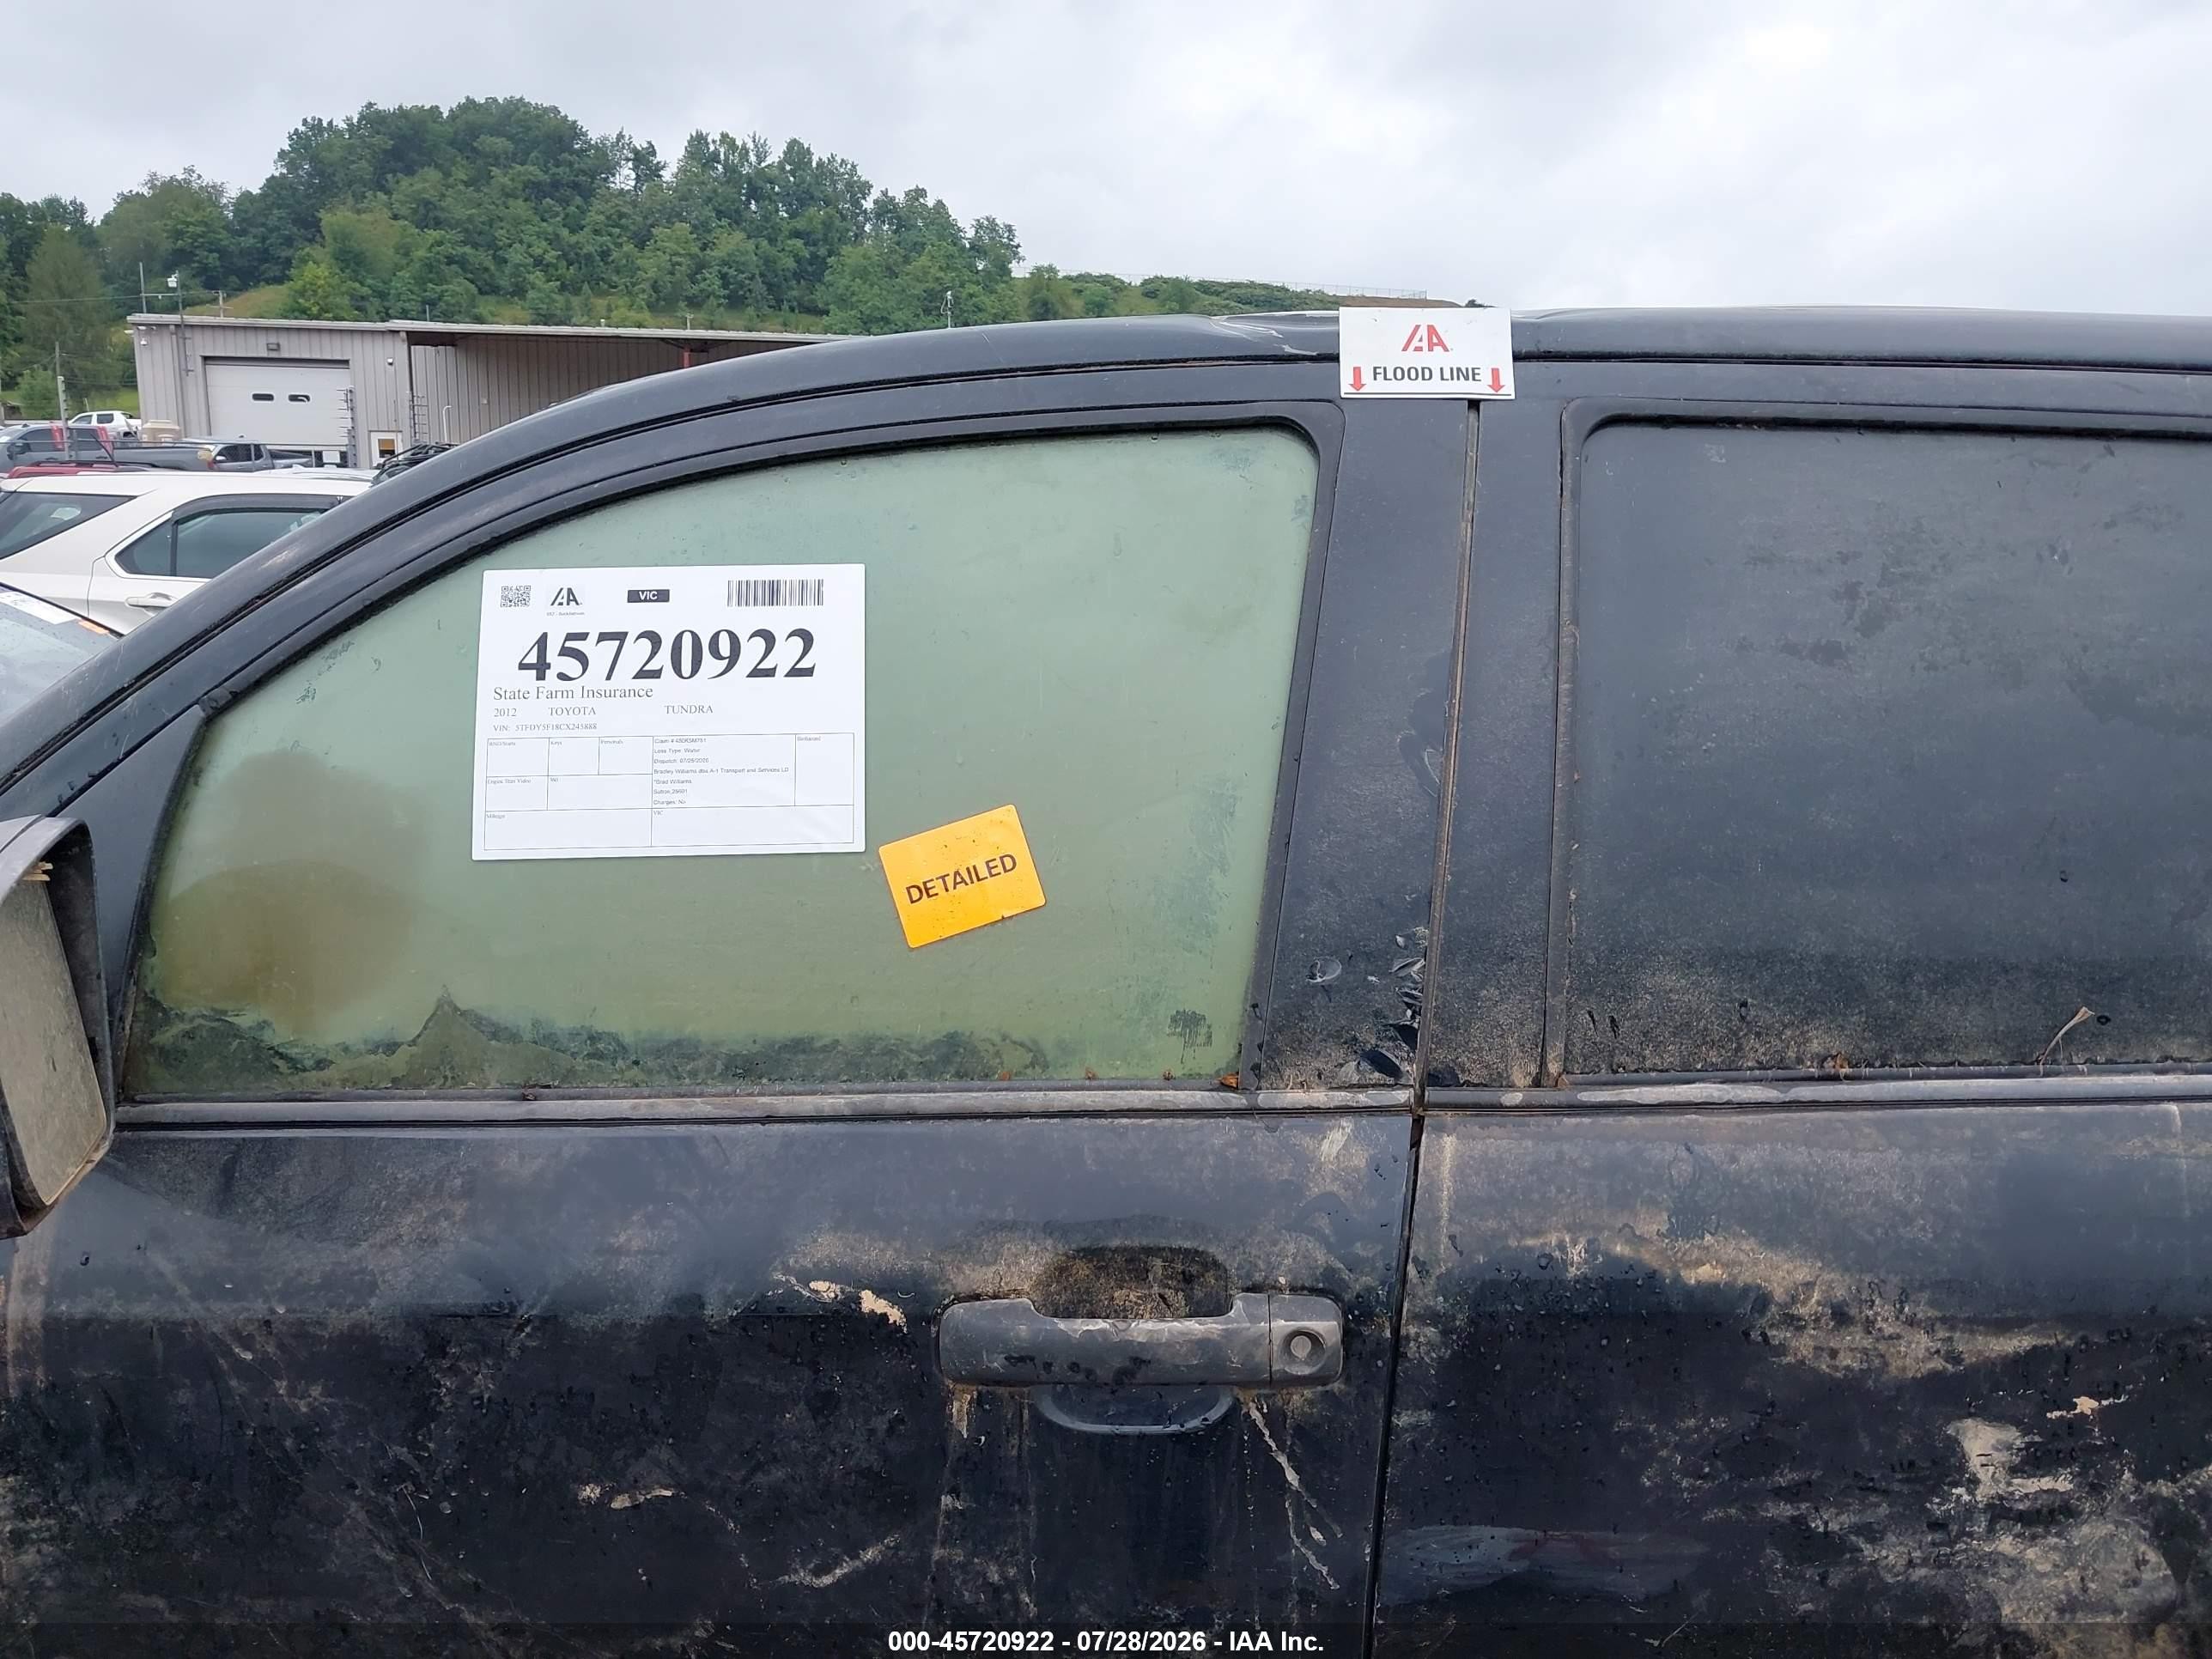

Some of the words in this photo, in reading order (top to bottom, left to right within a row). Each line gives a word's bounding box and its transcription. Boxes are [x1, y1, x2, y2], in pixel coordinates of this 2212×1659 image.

[1373, 366, 1433, 381] FLOOD
[1440, 367, 1482, 382] LINE
[638, 591, 659, 600] VIC
[518, 629, 817, 682] 45720922
[493, 686, 531, 701] State
[536, 686, 574, 700] Farm
[581, 685, 653, 699] Insurance
[494, 708, 517, 718] 2012
[548, 707, 597, 716] TOYOTA
[665, 704, 714, 714] TUNDRA
[905, 854, 1018, 904] DETAILED
